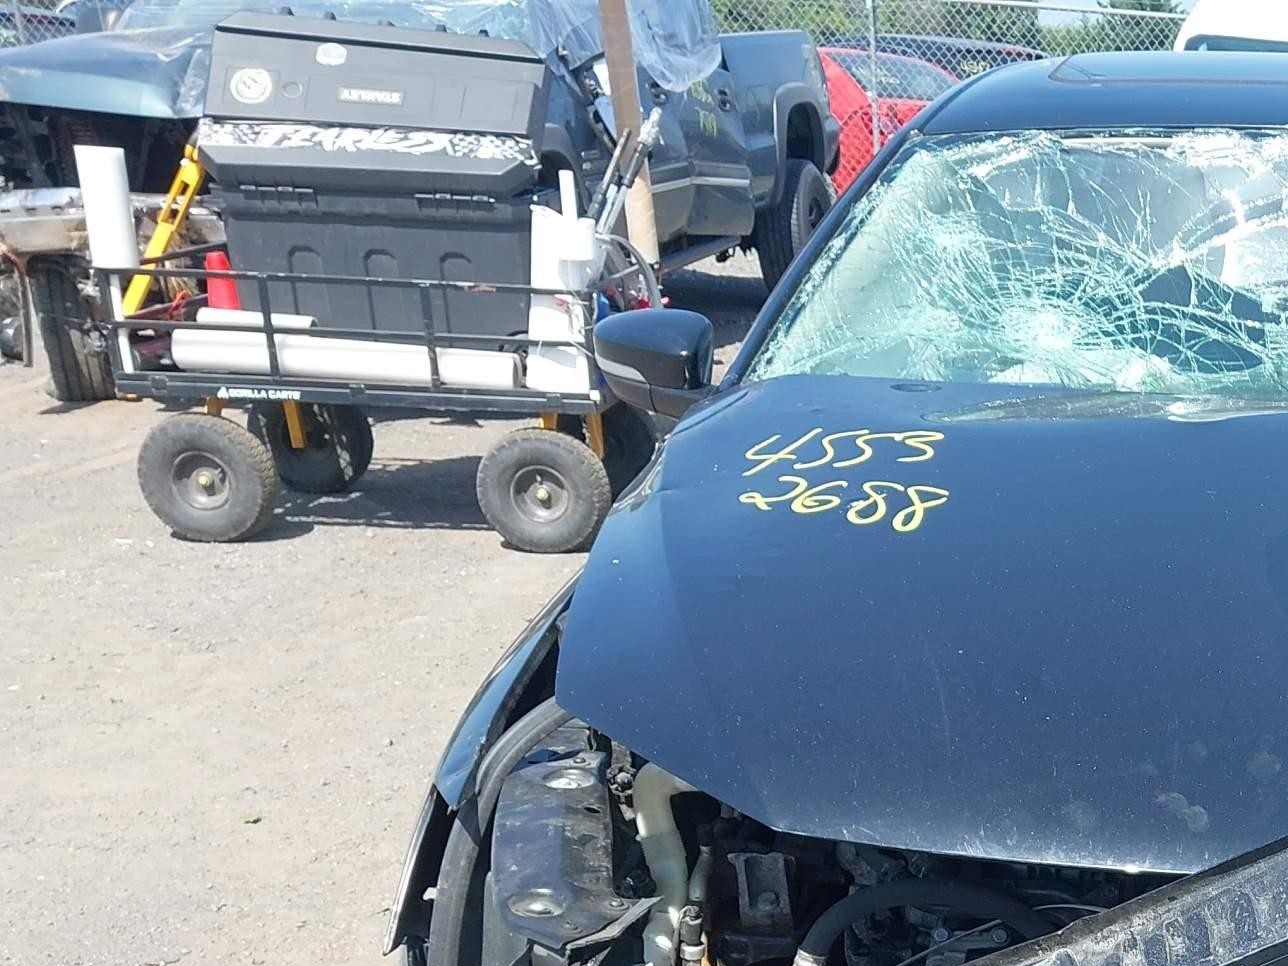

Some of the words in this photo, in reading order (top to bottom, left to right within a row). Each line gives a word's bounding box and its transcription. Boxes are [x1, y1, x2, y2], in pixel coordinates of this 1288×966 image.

[228, 387, 268, 399] GORILLA
[741, 427, 945, 477] 4553
[738, 475, 950, 532] 2688
